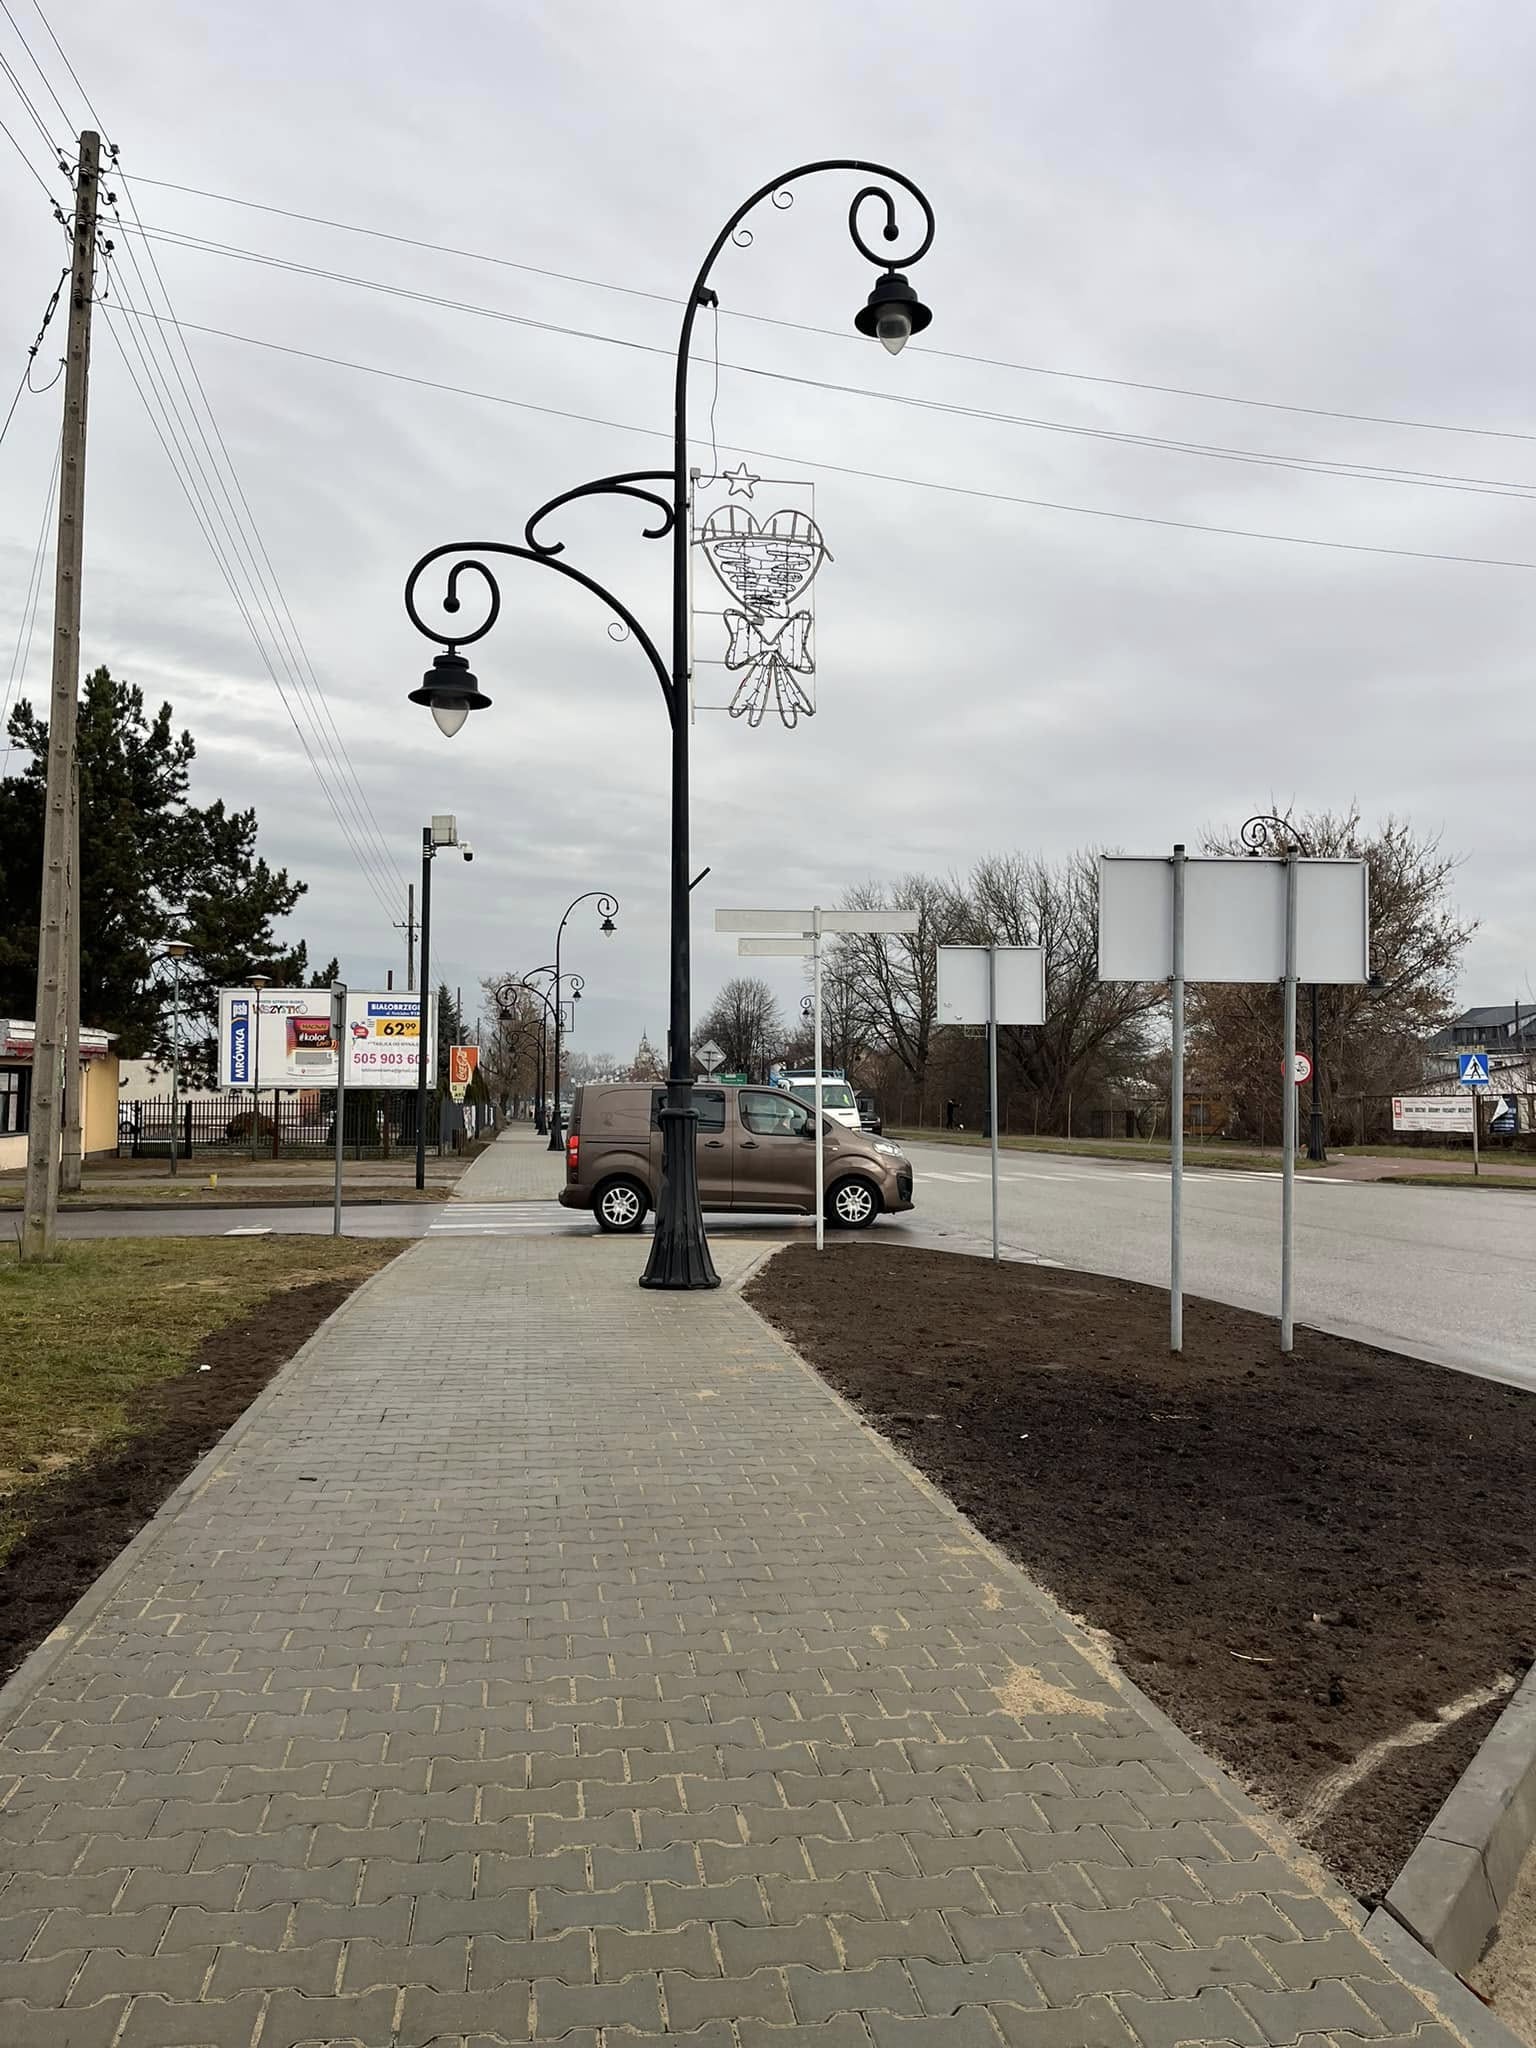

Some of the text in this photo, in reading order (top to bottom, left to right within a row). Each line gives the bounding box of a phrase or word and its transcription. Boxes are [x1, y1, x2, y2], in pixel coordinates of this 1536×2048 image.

[232, 1028, 245, 1079] MRÓWKA
[353, 1053, 377, 1064] 505
[380, 1053, 403, 1065] 903
